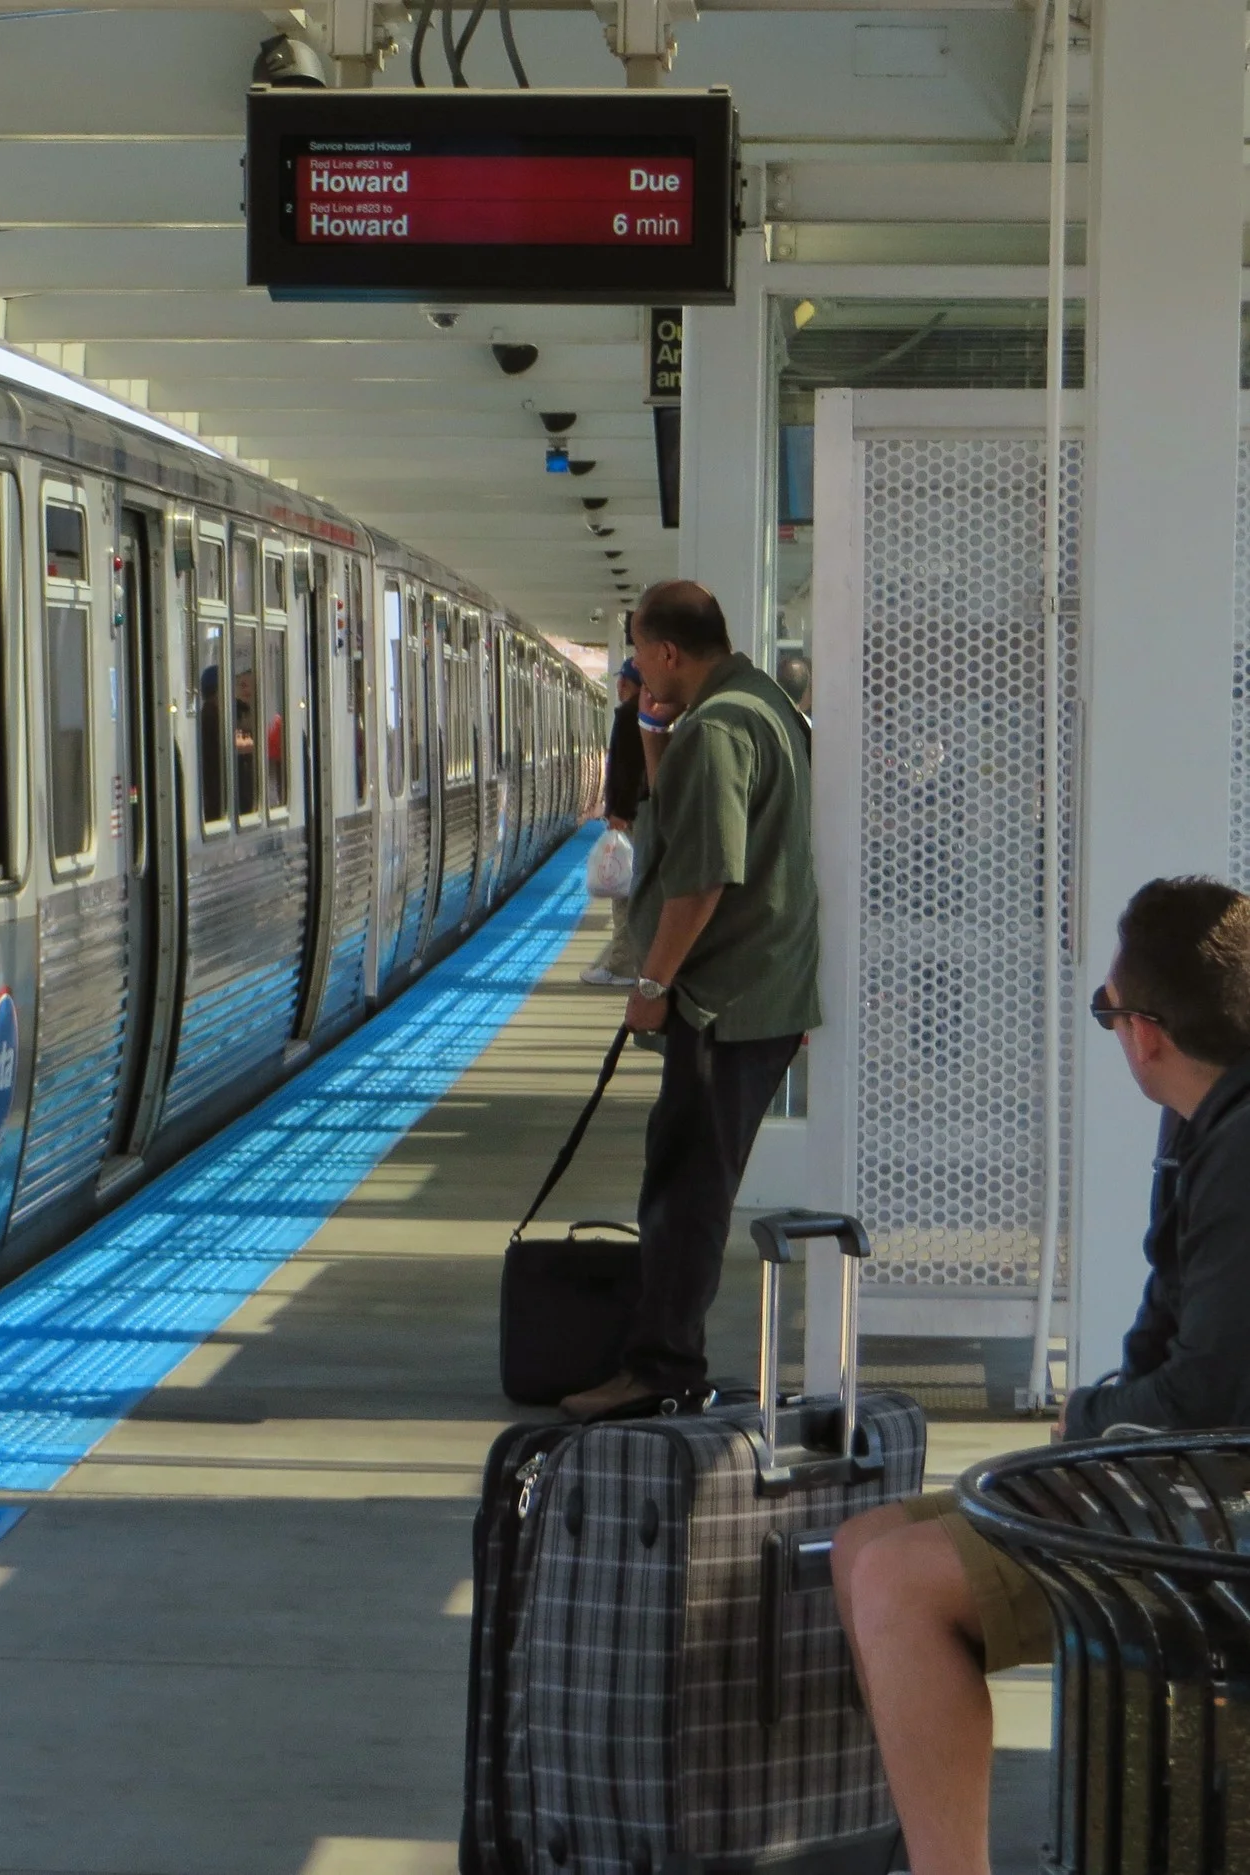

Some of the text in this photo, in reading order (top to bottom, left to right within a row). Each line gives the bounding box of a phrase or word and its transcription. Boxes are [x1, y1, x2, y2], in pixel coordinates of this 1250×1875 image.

[310, 142, 411, 151] Service toward Howard
[310, 160, 394, 169] Red Line #921 to
[310, 170, 409, 193] Howard
[629, 169, 680, 191] Due
[285, 203, 293, 213] 2
[310, 203, 330, 213] Red
[332, 203, 353, 213] Line
[383, 203, 394, 213] to
[310, 214, 409, 236] Howard
[612, 213, 679, 236] 6 min
